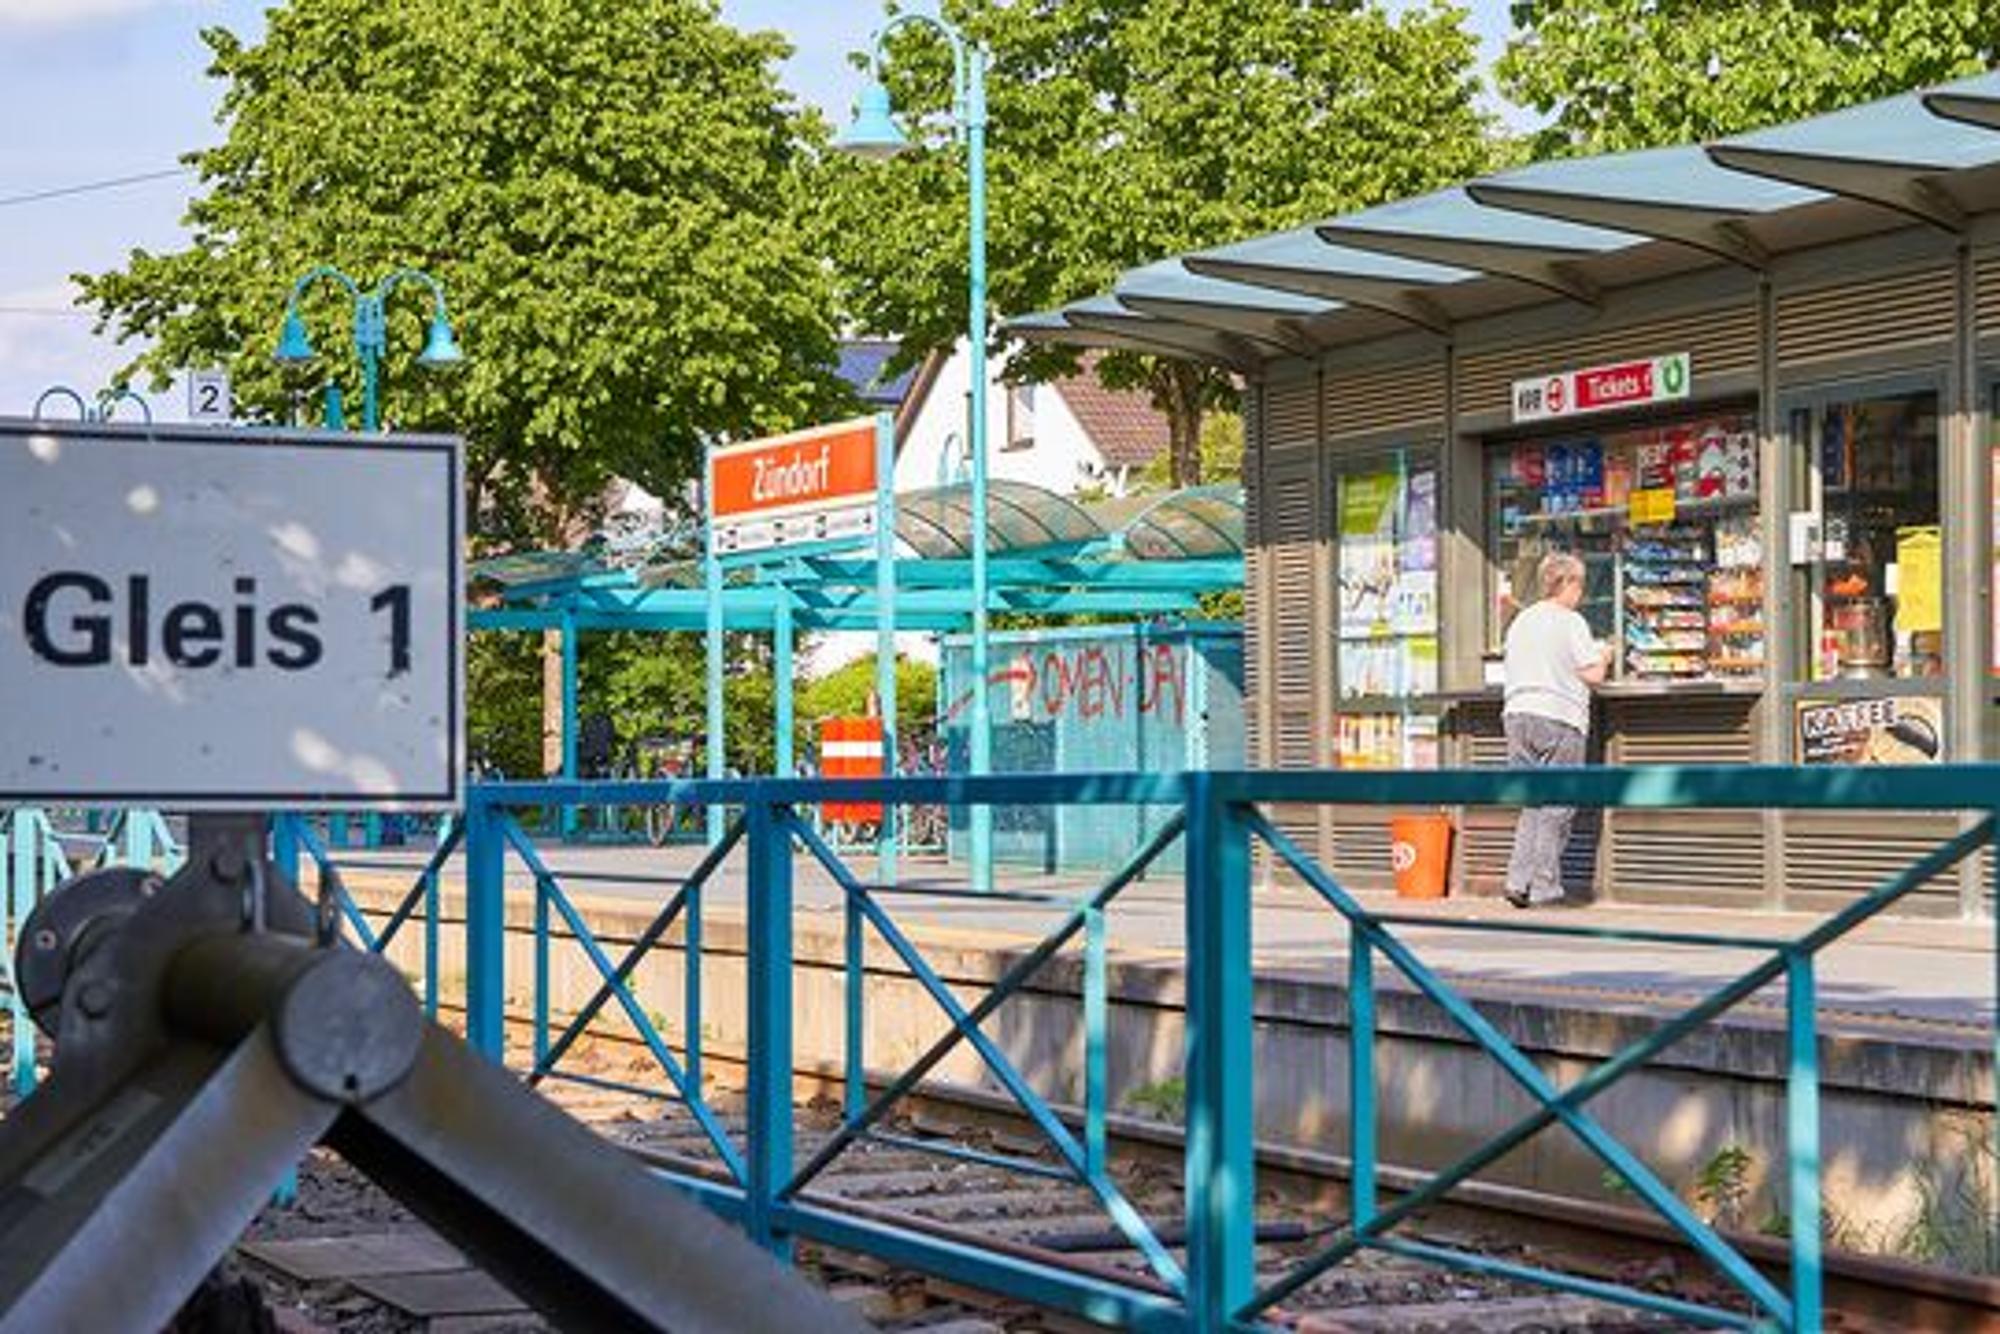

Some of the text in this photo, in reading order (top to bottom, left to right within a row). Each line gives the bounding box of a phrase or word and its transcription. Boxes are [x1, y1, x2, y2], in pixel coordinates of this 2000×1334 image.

[199, 384, 219, 413] 2
[752, 444, 831, 502] Zündorf
[23, 571, 412, 679] Gleis 1
[1802, 699, 1896, 738] KAFFEE
